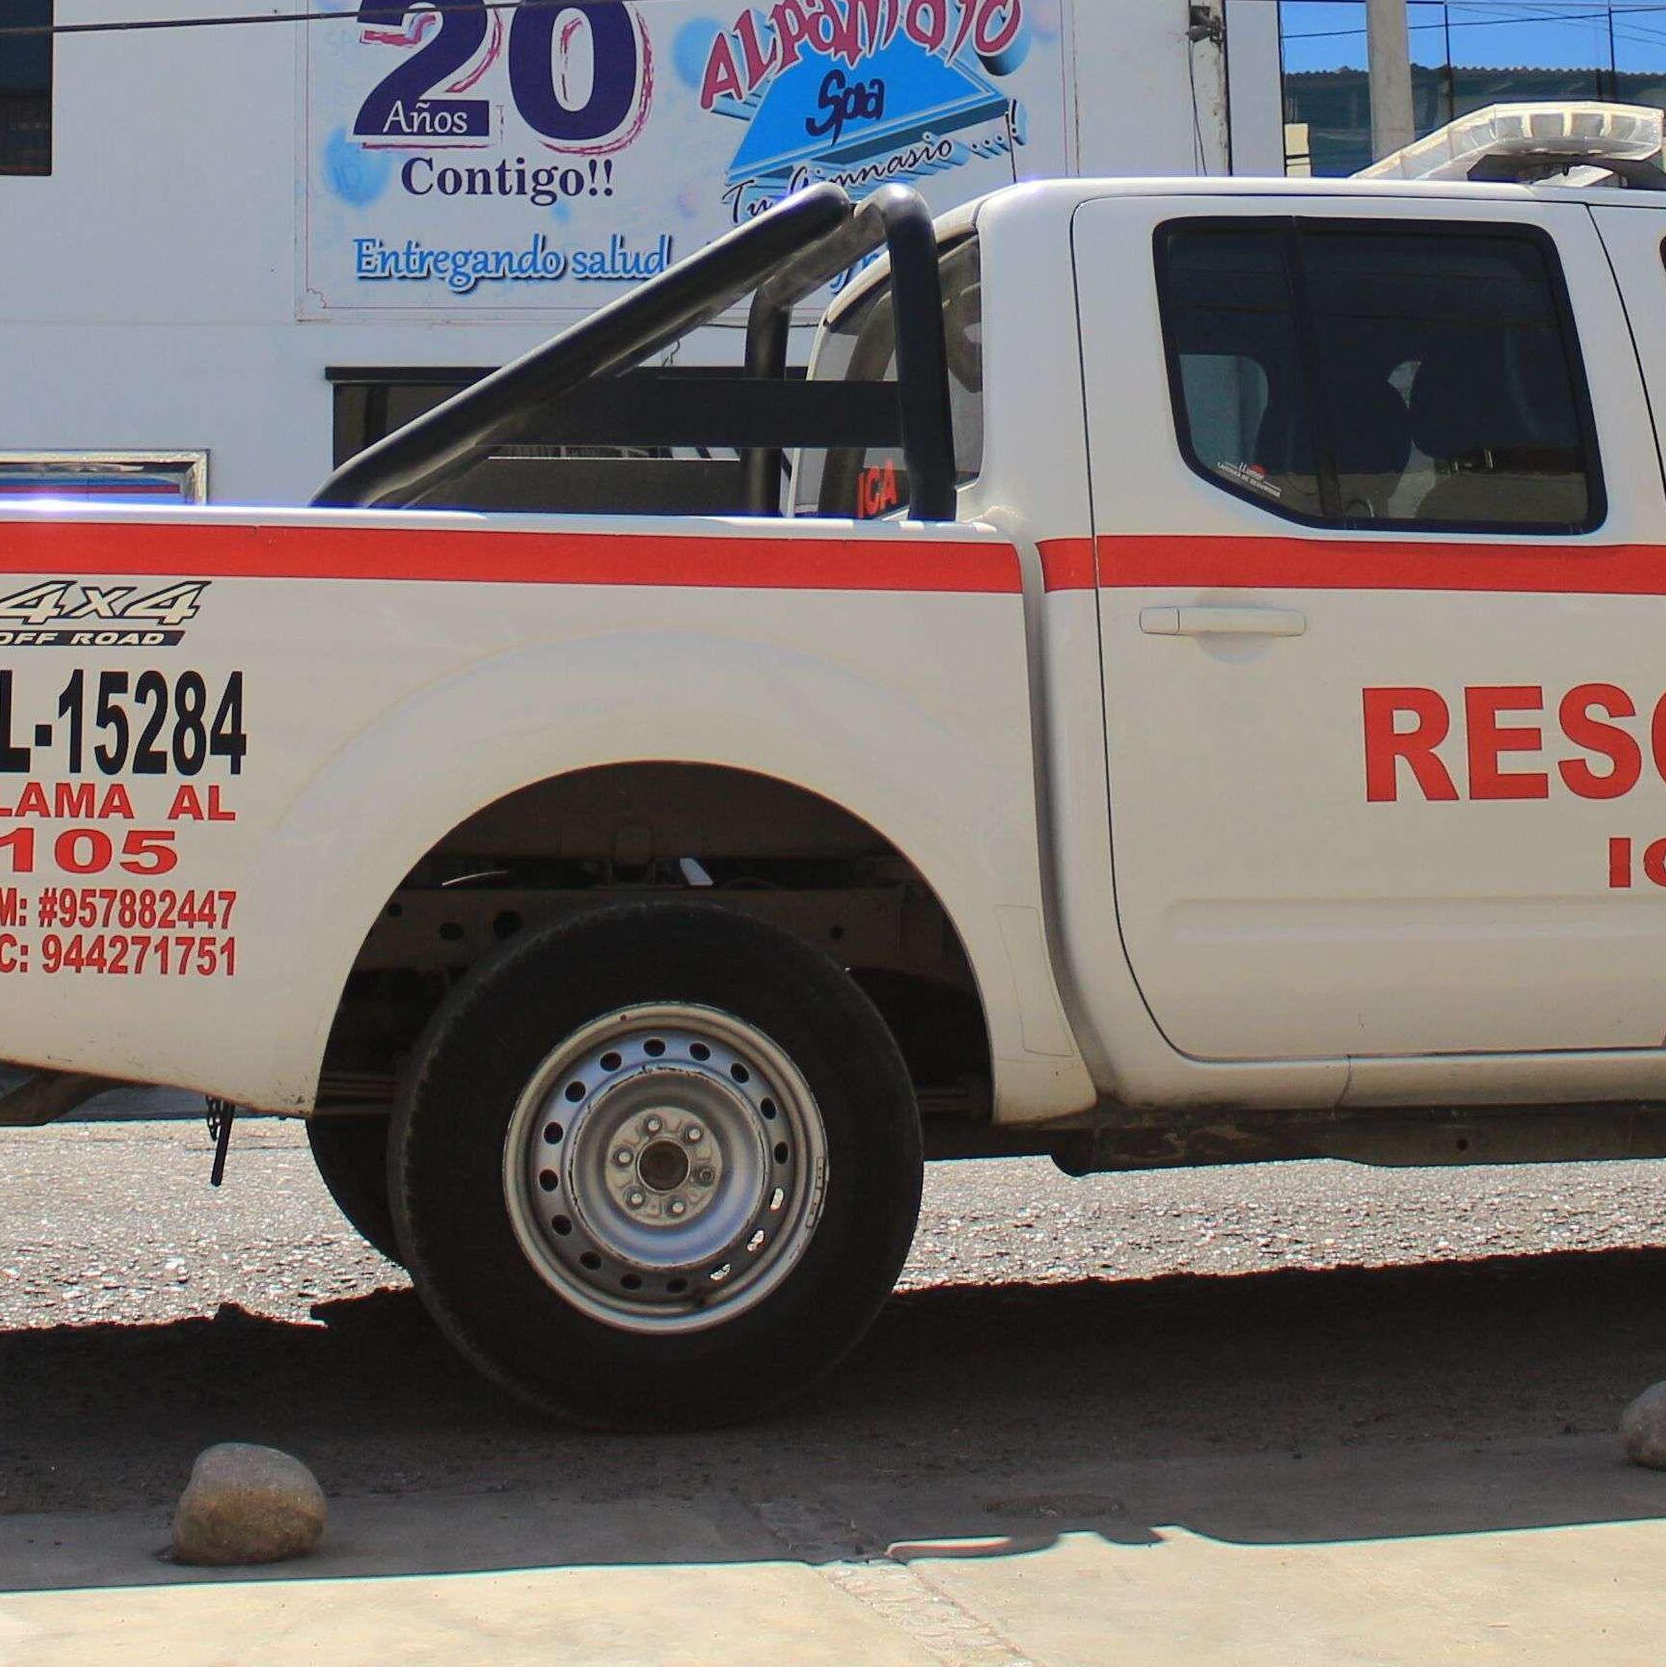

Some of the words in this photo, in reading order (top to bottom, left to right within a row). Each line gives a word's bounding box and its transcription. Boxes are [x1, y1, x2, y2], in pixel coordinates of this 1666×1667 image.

[383, 103, 469, 134] Años
[805, 69, 885, 147] Spa
[401, 157, 614, 207] Contigo!!
[790, 139, 952, 196] Gmnasio
[354, 234, 566, 291] Entregando
[571, 234, 671, 279] salud
[857, 456, 899, 519] ICA
[68, 632, 165, 646] ROAD
[168, 784, 237, 821] AL
[38, 887, 237, 929] #957882447
[41, 935, 236, 975] 944271751
